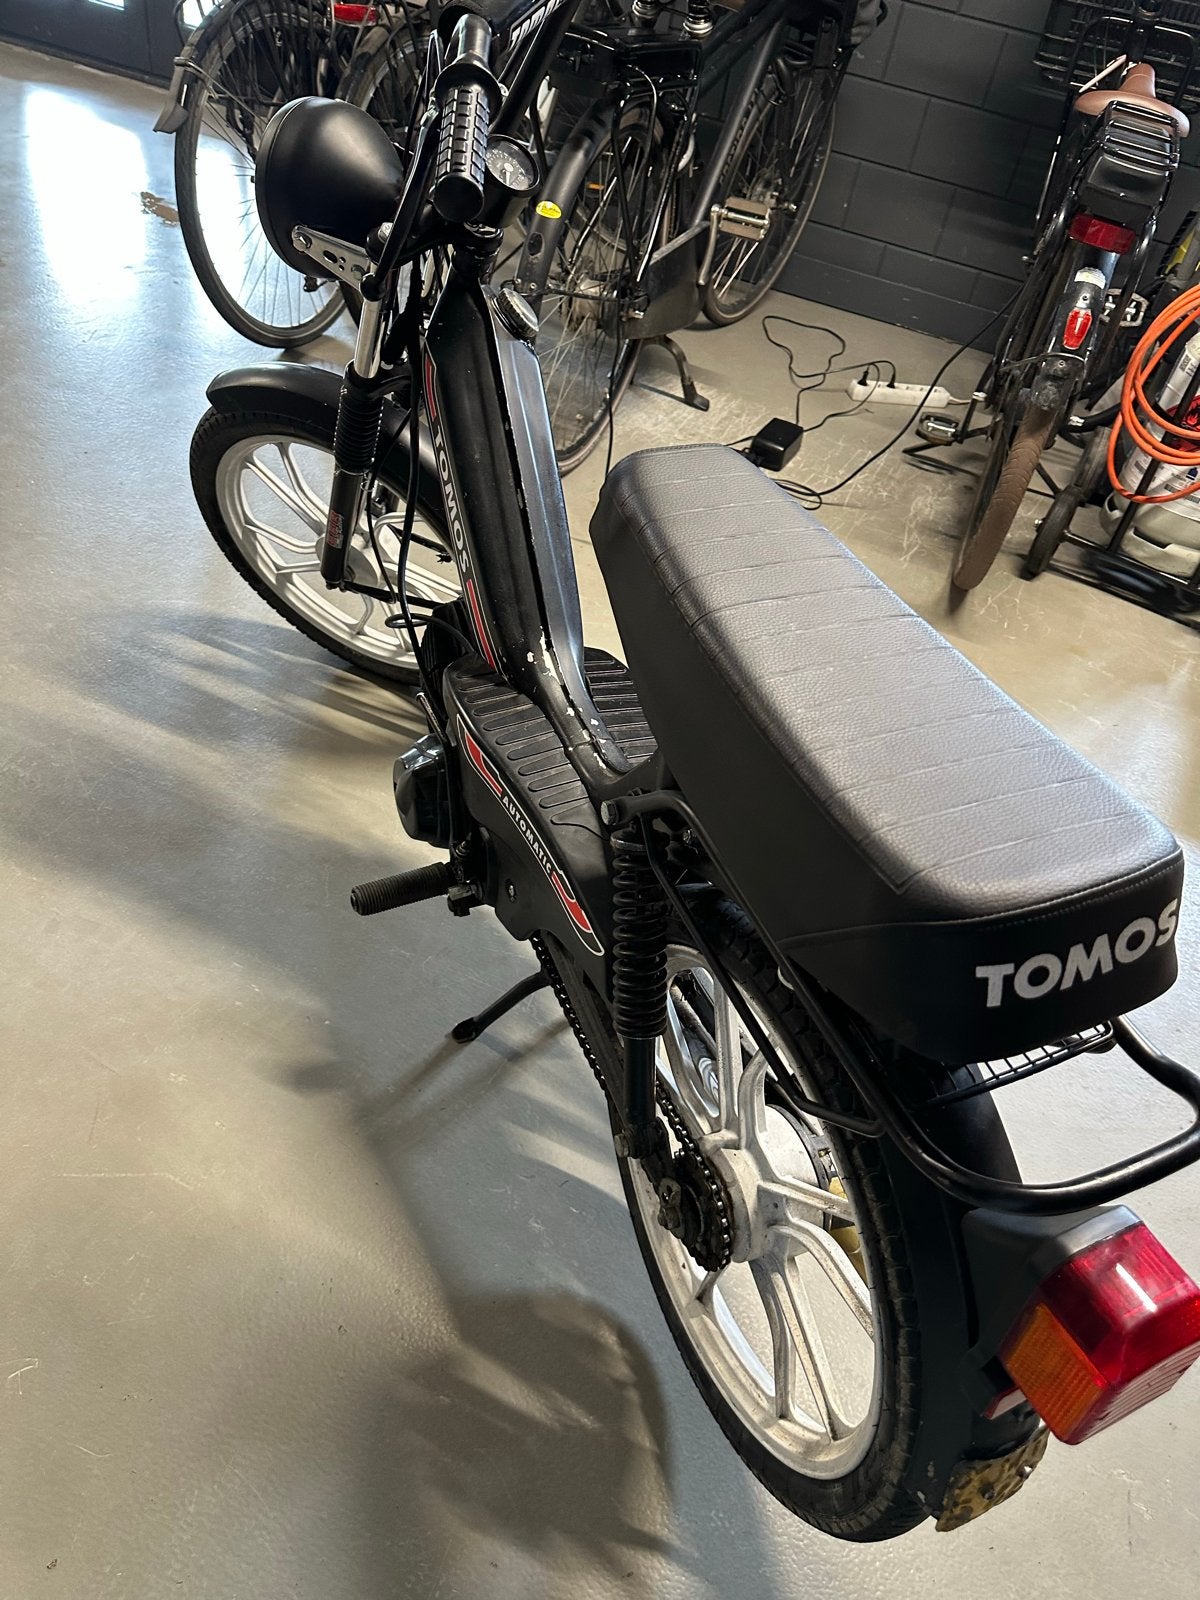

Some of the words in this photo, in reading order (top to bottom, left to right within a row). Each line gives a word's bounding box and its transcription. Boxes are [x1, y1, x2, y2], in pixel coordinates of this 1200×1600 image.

[435, 425, 469, 573] TOMOS
[502, 797, 552, 874] AUTOMATIC
[975, 898, 1178, 1007] TOMOS
